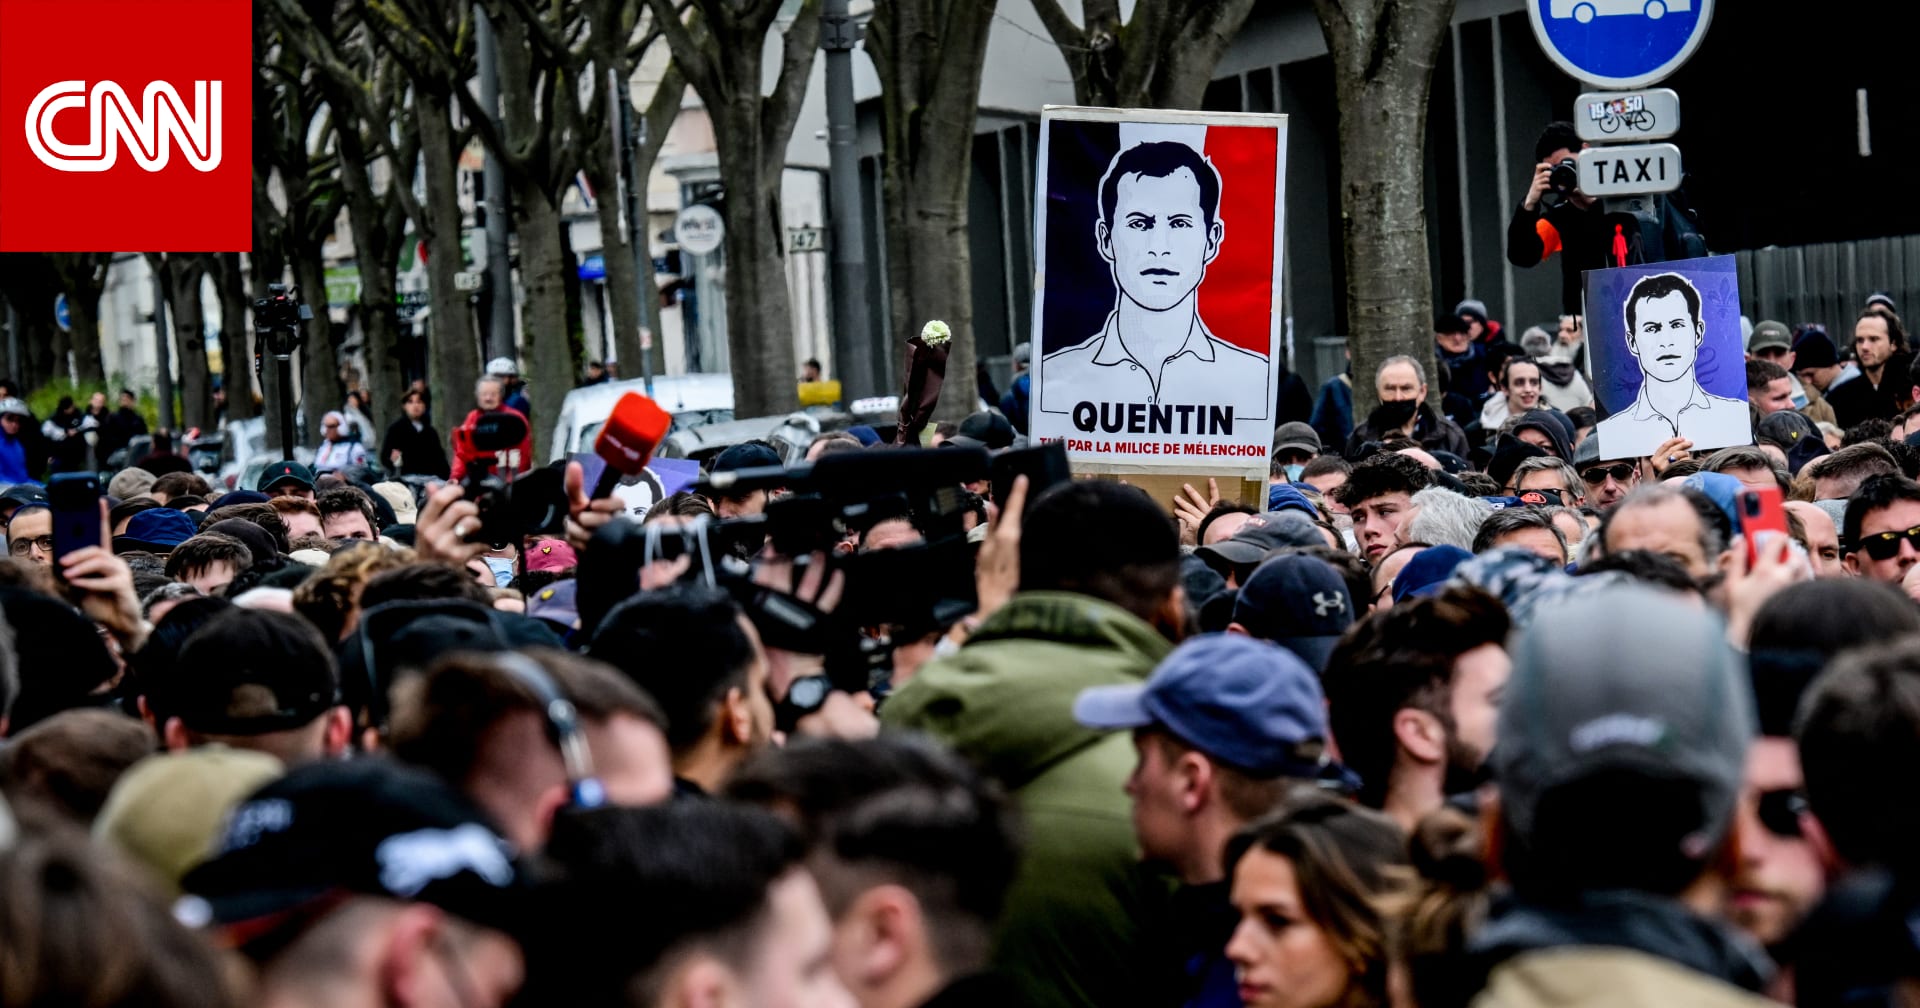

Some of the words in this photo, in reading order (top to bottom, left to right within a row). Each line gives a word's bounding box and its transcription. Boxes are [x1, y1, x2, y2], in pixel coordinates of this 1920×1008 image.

[1625, 95, 1643, 113] 50
[1593, 157, 1665, 184] TAXI
[791, 231, 817, 248] 147
[1073, 401, 1234, 435] QUENTIN
[1067, 439, 1093, 451] PAR
[1096, 441, 1112, 453] LA
[1115, 442, 1160, 454] MILICE
[1163, 443, 1180, 454] DE
[1184, 441, 1266, 456] MÉLENCHON
